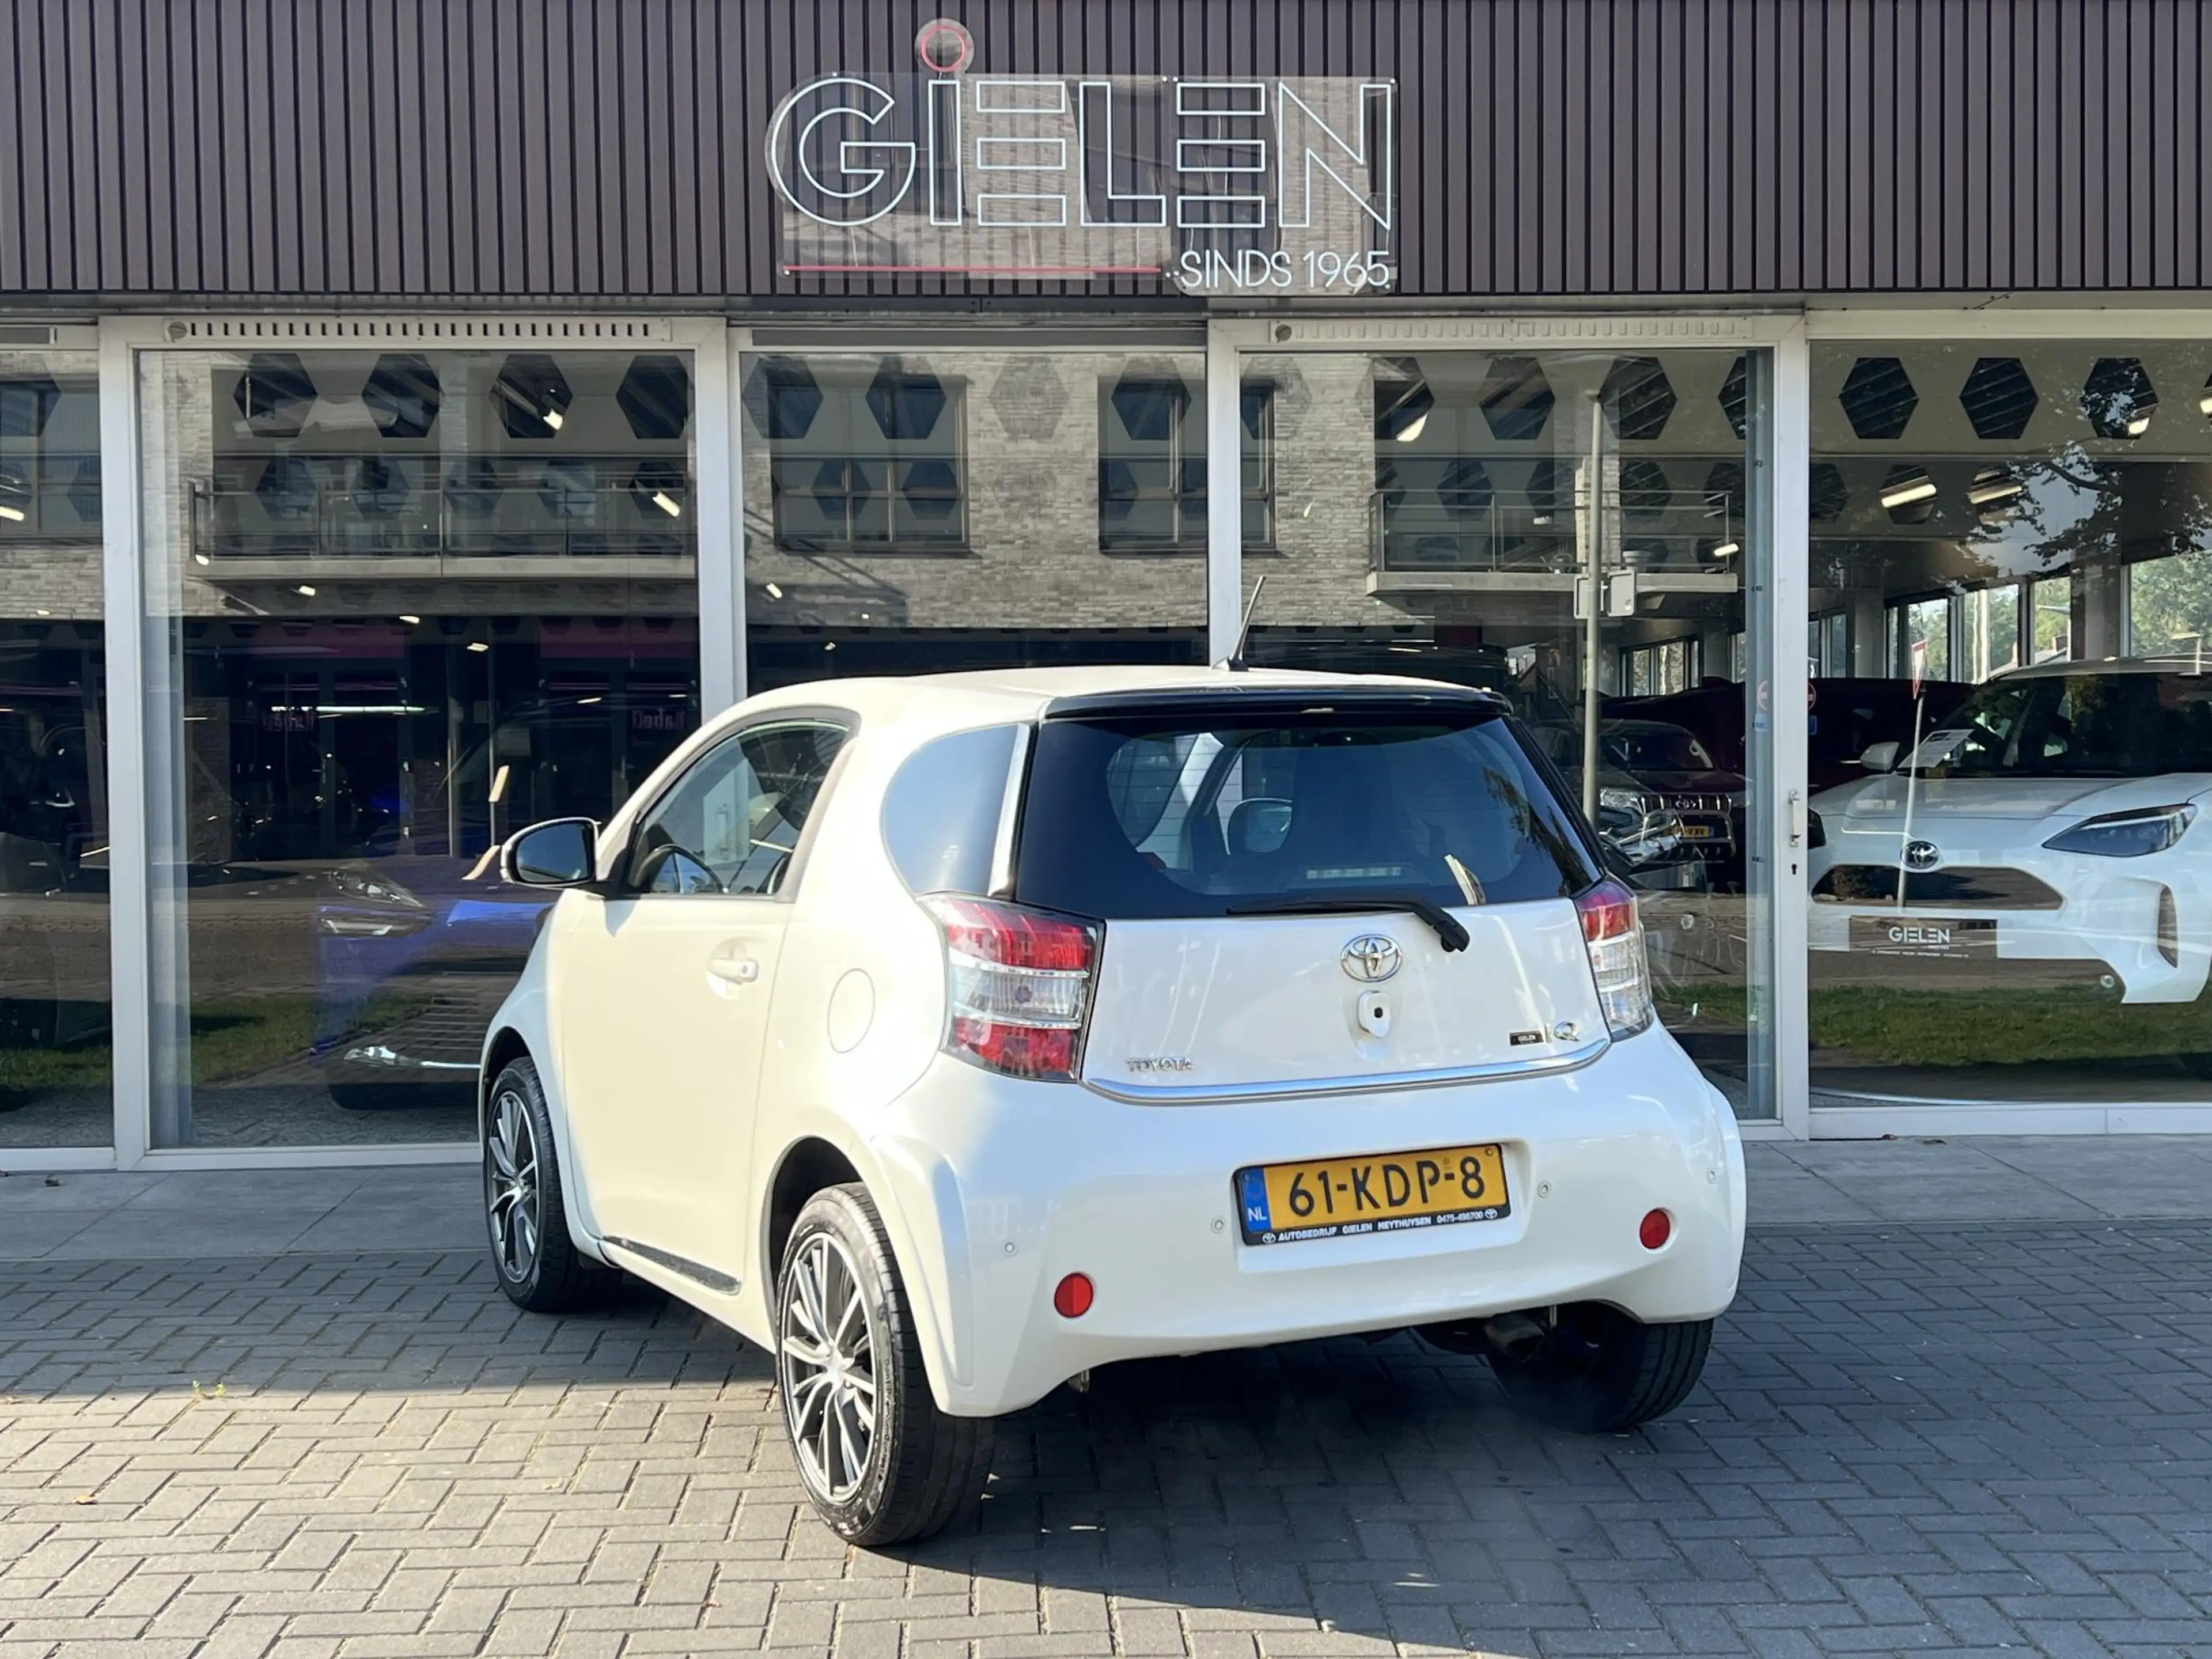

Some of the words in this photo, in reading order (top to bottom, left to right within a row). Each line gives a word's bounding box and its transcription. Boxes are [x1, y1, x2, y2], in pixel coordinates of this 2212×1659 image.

[1179, 250, 1292, 289] SINDS
[1304, 249, 1391, 289] 1965
[1888, 926, 1950, 943] GIELEN
[1125, 1057, 1194, 1073] TOYOTA
[1289, 1156, 1485, 1217] 61-KDP-8
[1248, 1207, 1267, 1222] NL
[1278, 1226, 1337, 1242] AUTOBEDRIJF
[1342, 1222, 1372, 1234] GIELEN
